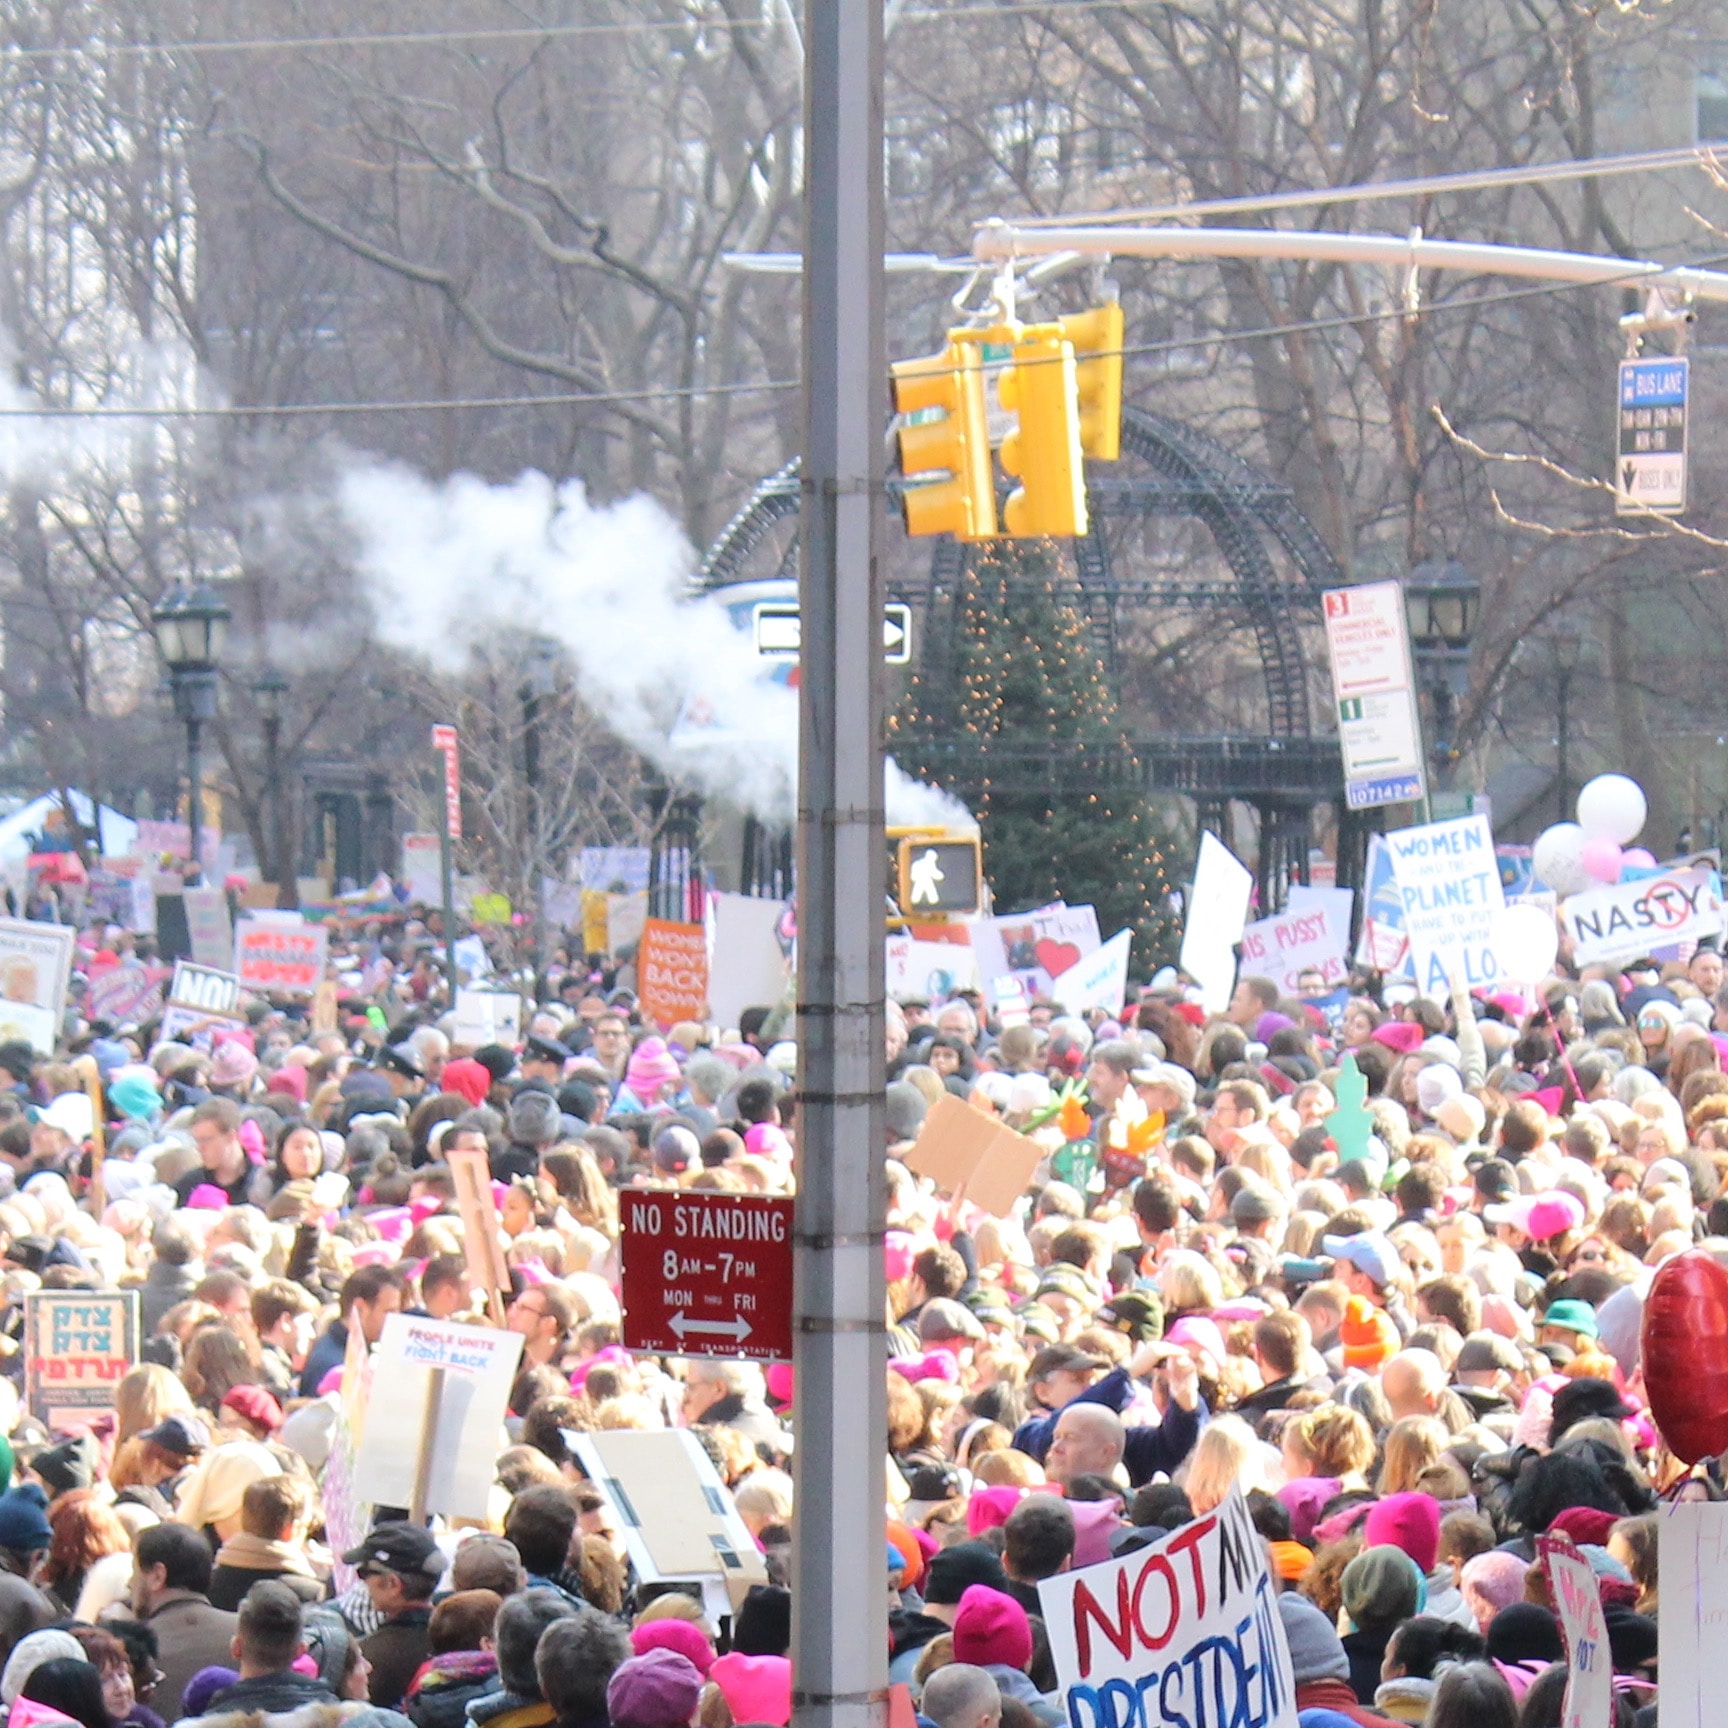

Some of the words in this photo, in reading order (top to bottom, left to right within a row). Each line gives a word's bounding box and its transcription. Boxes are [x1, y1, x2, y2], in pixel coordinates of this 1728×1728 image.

[1393, 825, 1484, 860] WOMEN
[1401, 872, 1491, 914] PLANET
[1574, 883, 1702, 943] NASTY
[648, 929, 707, 949] WOME
[1274, 911, 1328, 950] PUSSY
[646, 963, 708, 989] BACK
[631, 1203, 664, 1237] NO
[674, 1205, 787, 1243] STANDING
[662, 1250, 757, 1284] 8AM-7PM
[663, 1288, 695, 1306] MON
[733, 1291, 757, 1311] FRI
[408, 1326, 453, 1345] PEOPLE
[457, 1334, 496, 1352] UNITE
[404, 1344, 446, 1363] FIGHT
[450, 1352, 488, 1370] BACK
[1071, 1514, 1217, 1678] NOT
[1215, 1486, 1263, 1608] MY
